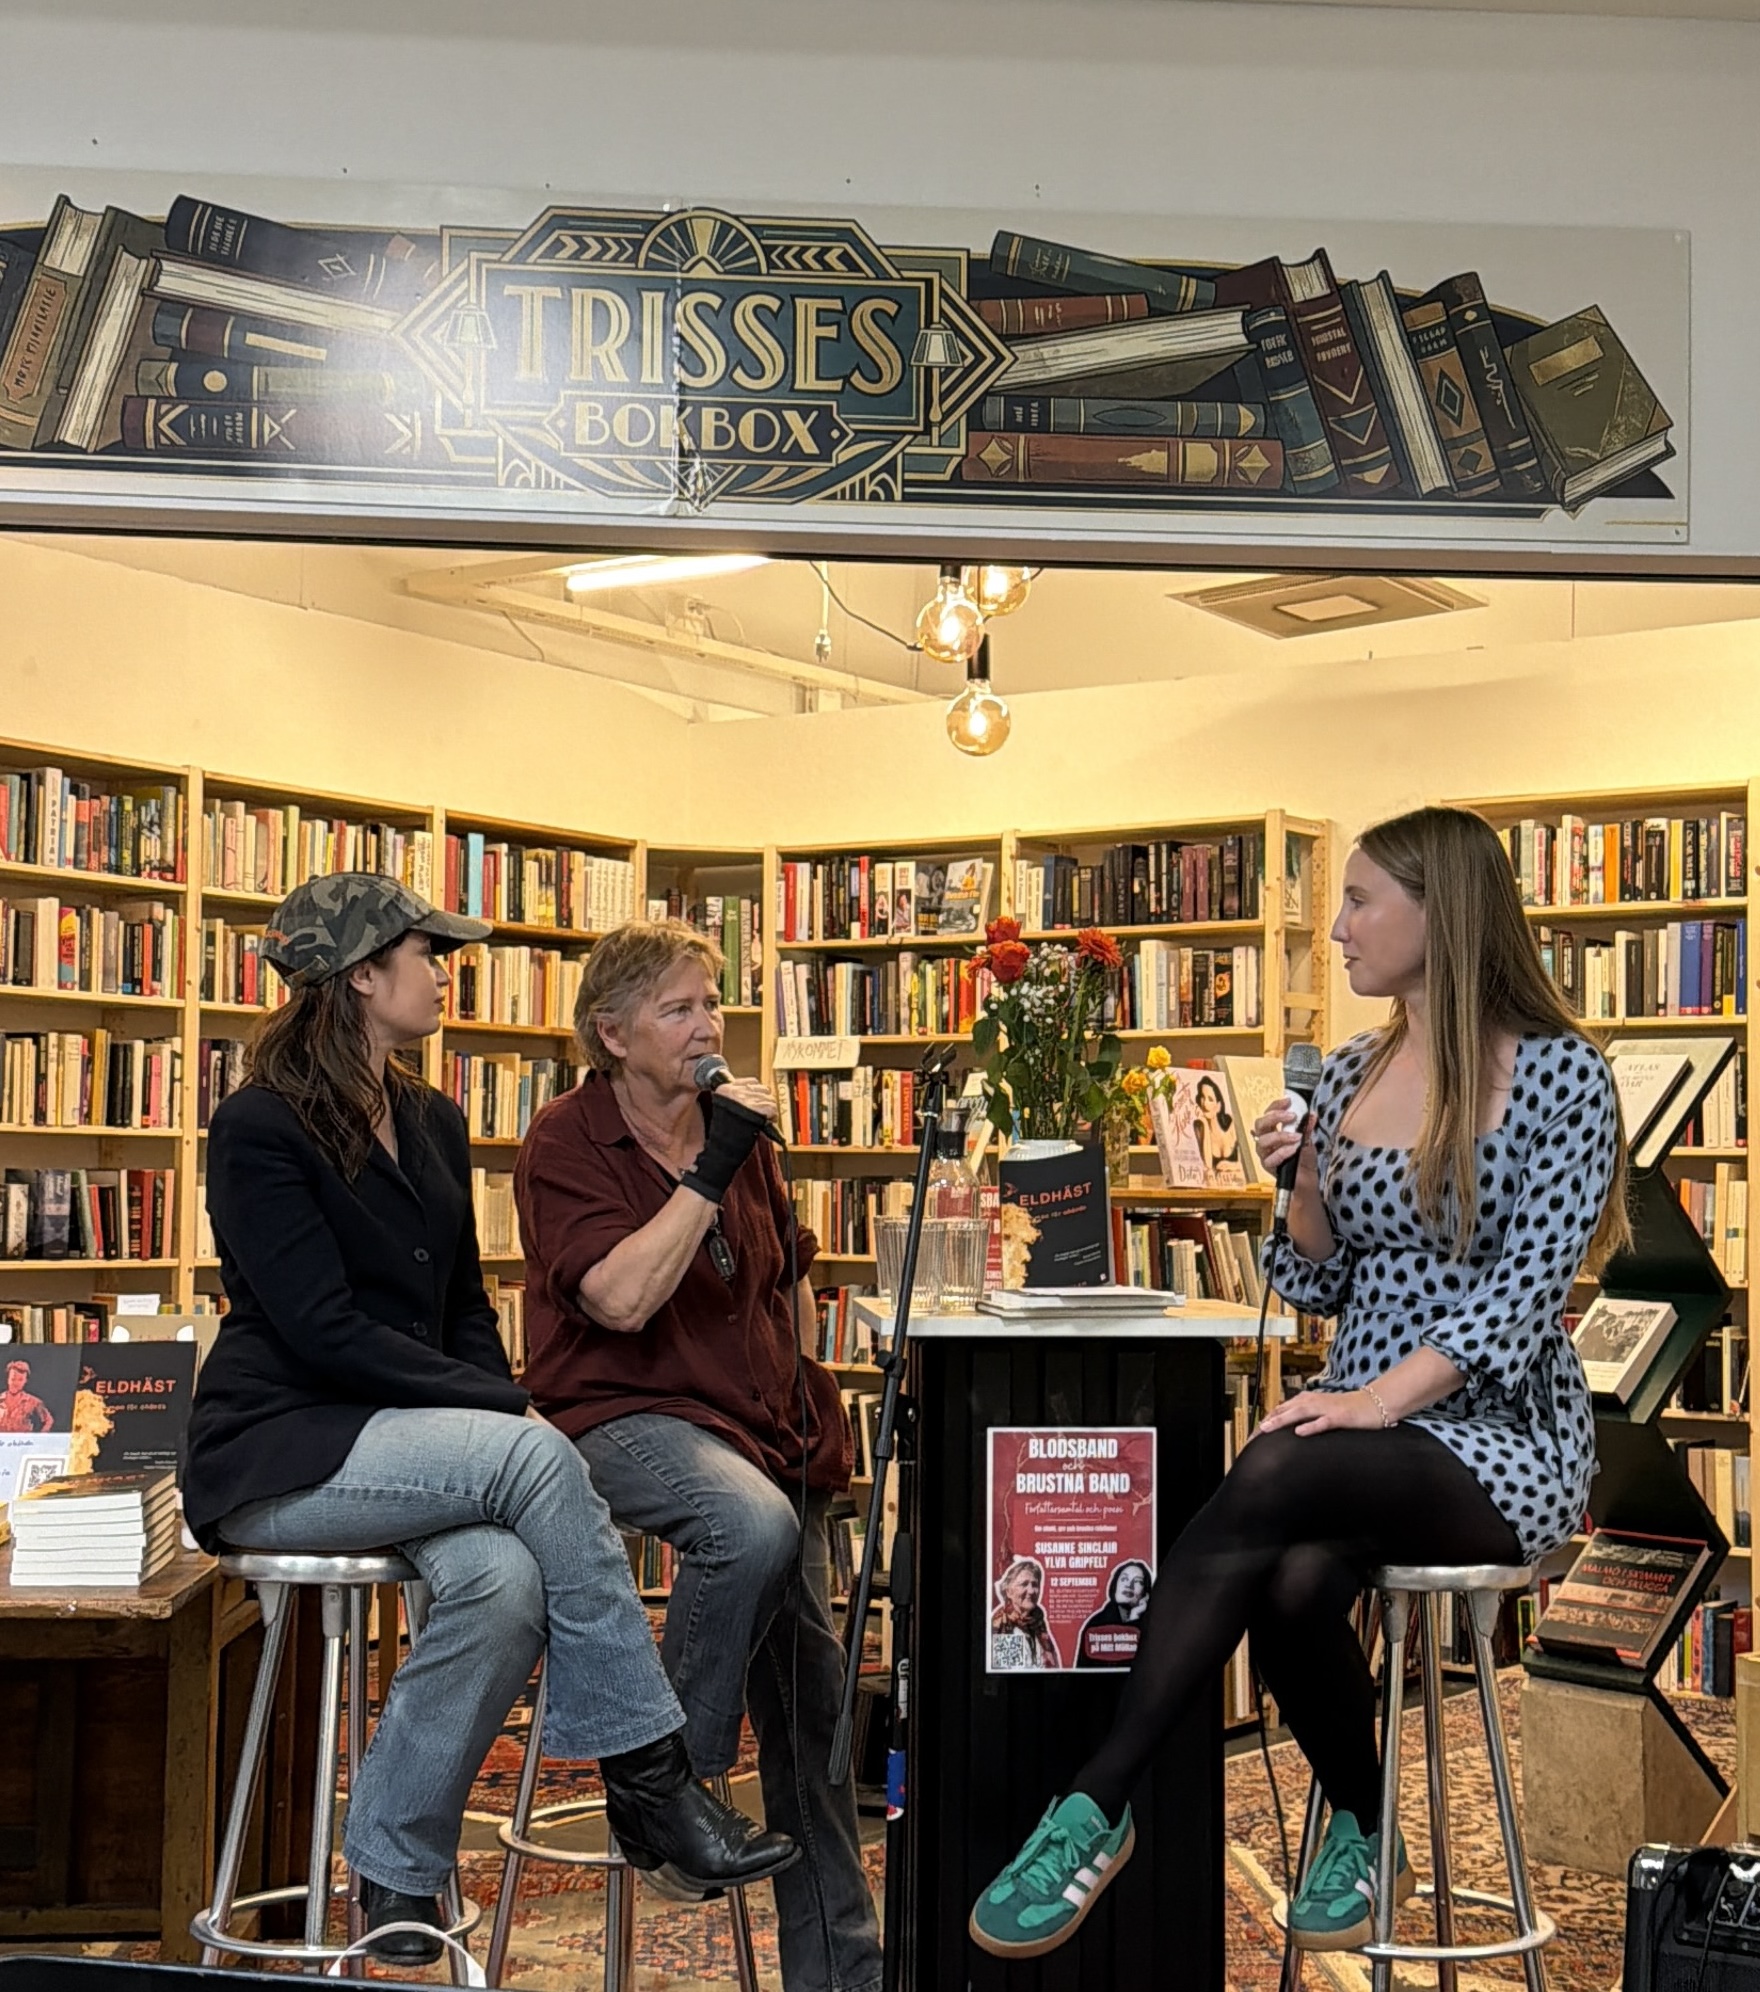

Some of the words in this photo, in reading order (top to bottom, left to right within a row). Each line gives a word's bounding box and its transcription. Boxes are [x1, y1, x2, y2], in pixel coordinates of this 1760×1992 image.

[503, 285, 903, 396] TRISSES
[573, 400, 821, 456] BOKBOX
[777, 1074, 788, 1115] NORA
[1019, 1181, 1093, 1207] ELDHÄST
[95, 1376, 176, 1395] ELDHÄST
[1028, 1438, 1118, 1459] BLODSBAND
[1016, 1472, 1085, 1494] BRUSTNA
[1088, 1472, 1131, 1494] BAND
[1034, 1541, 1076, 1554] SUSANNE
[1077, 1541, 1118, 1554] SINCLAIR
[1044, 1556, 1067, 1568] YLVA
[1068, 1556, 1108, 1568] GRIPFELT
[1582, 1563, 1620, 1576] MALMÖ
[1058, 1576, 1098, 1587] SEPTEMBER
[1602, 1576, 1626, 1587] OCH
[1626, 1579, 1669, 1593] SKUGGA
